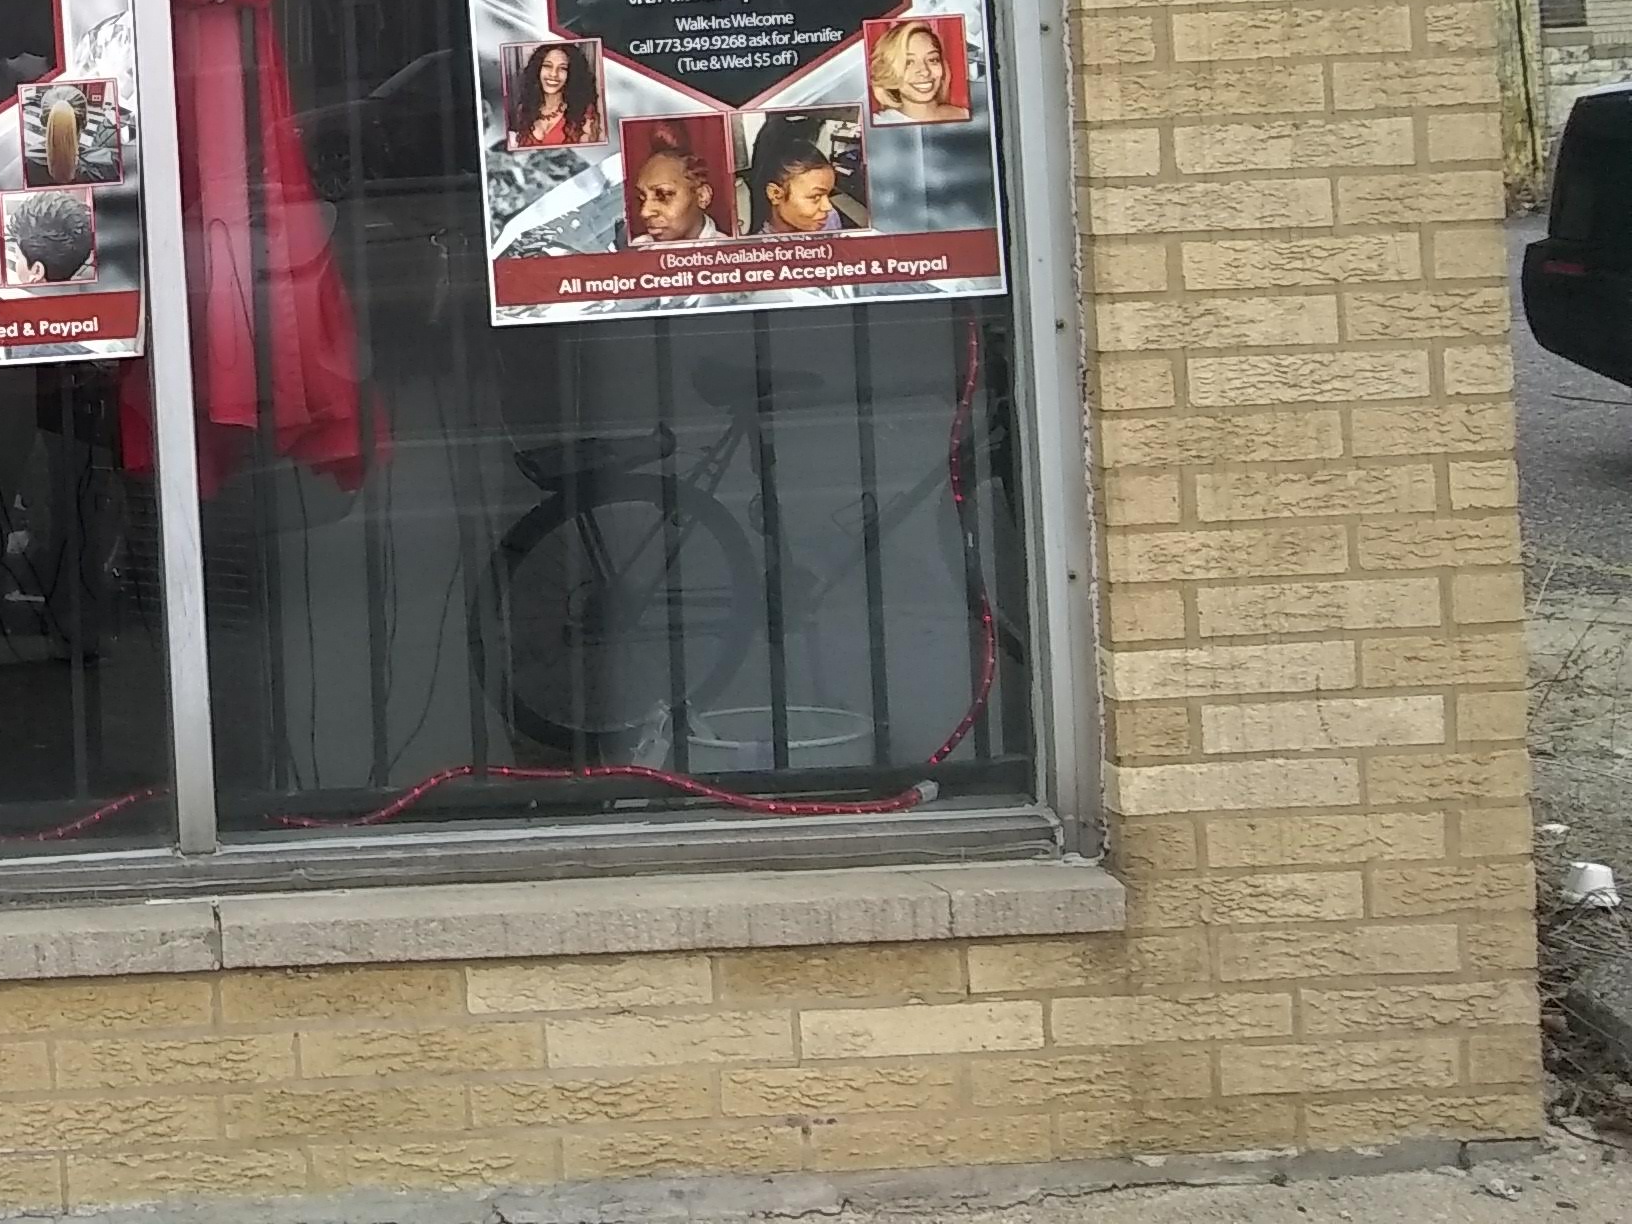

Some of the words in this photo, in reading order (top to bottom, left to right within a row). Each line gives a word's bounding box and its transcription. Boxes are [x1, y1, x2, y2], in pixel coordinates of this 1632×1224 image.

[675, 15, 731, 32] Walk-Ins
[731, 12, 794, 28] Welcome
[629, 40, 654, 55] Call
[655, 34, 747, 53] 773.949.9268
[749, 32, 772, 47] ask
[772, 31, 791, 46] for
[791, 27, 844, 45] Jennifer
[754, 52, 770, 69] $5
[715, 247, 774, 265] Available
[775, 246, 795, 261] for
[559, 278, 582, 294] All
[585, 275, 637, 294] major
[640, 272, 693, 289] Credit
[697, 268, 741, 284] Card
[744, 269, 774, 283] are
[778, 260, 866, 281] Accepted
[870, 260, 883, 274] &
[887, 255, 948, 276] Paypal
[23, 322, 36, 336] &
[39, 316, 100, 337] Paypal
